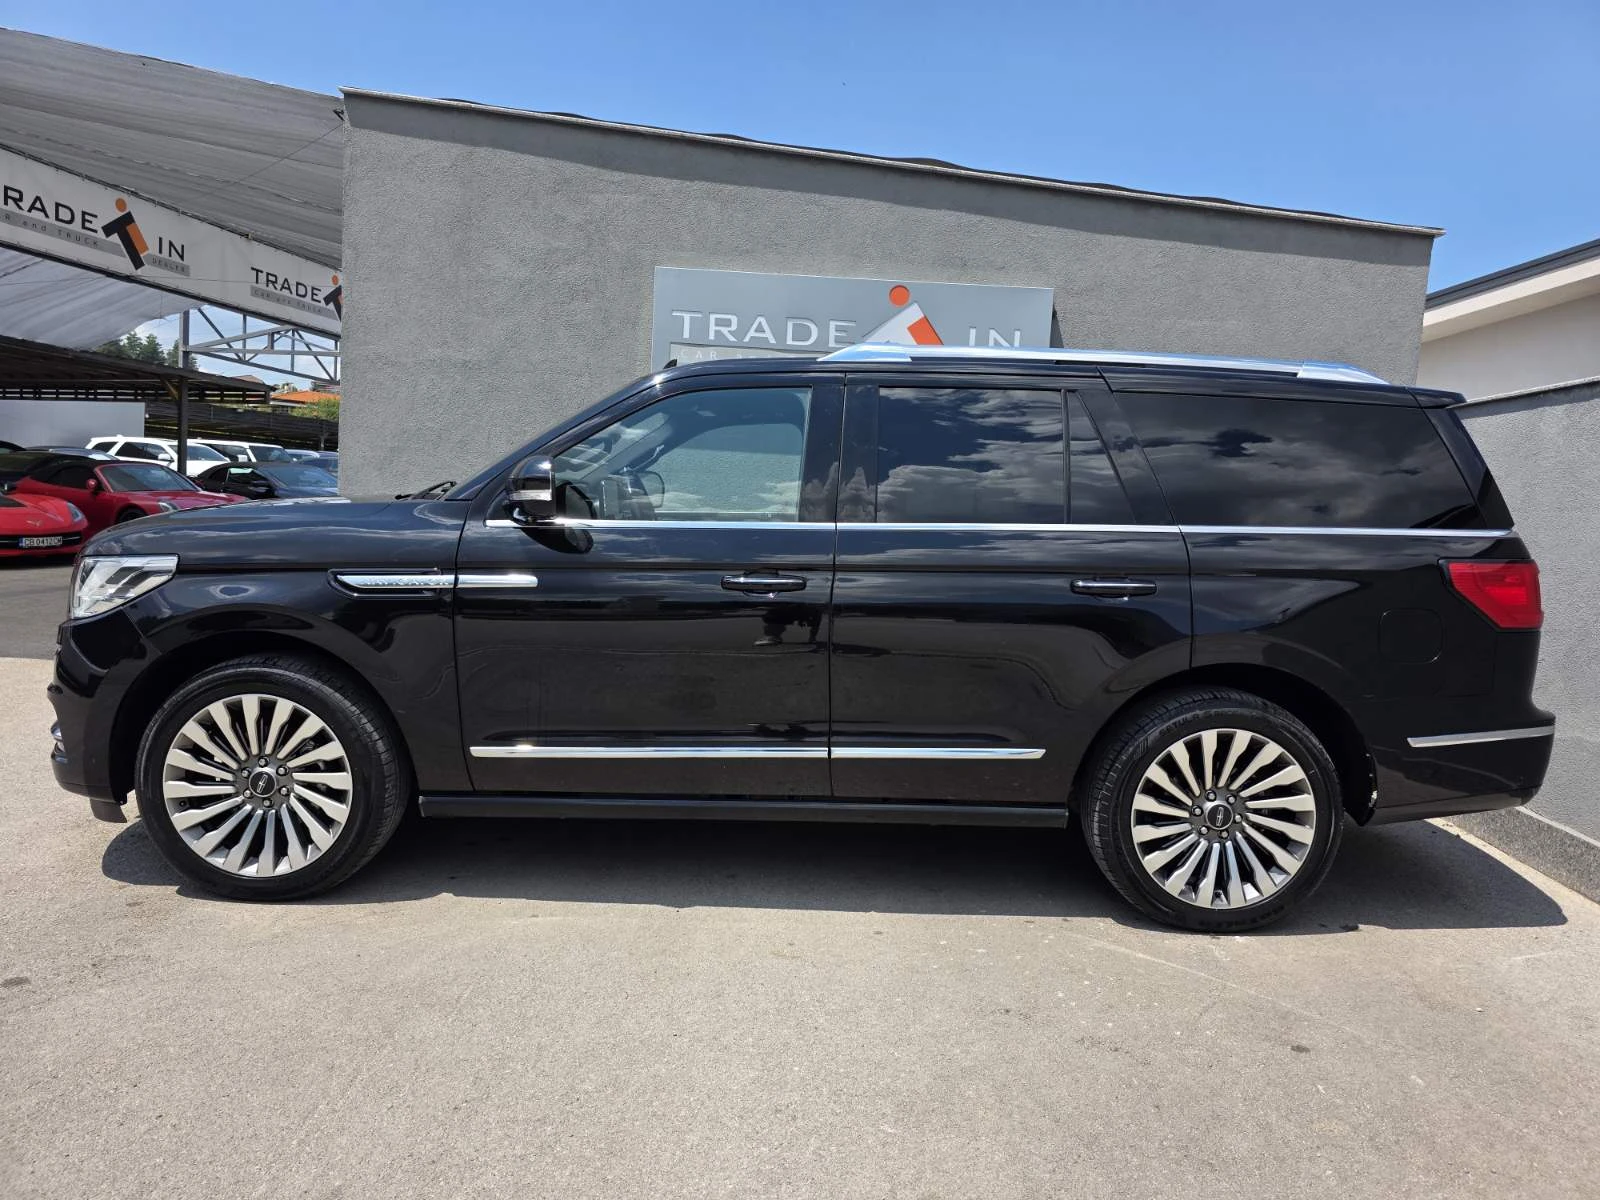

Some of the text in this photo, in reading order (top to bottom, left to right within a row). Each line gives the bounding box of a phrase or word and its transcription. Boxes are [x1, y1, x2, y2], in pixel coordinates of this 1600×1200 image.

[158, 236, 185, 262] IN
[250, 266, 322, 304] TRADE
[671, 310, 857, 349] TRADE
